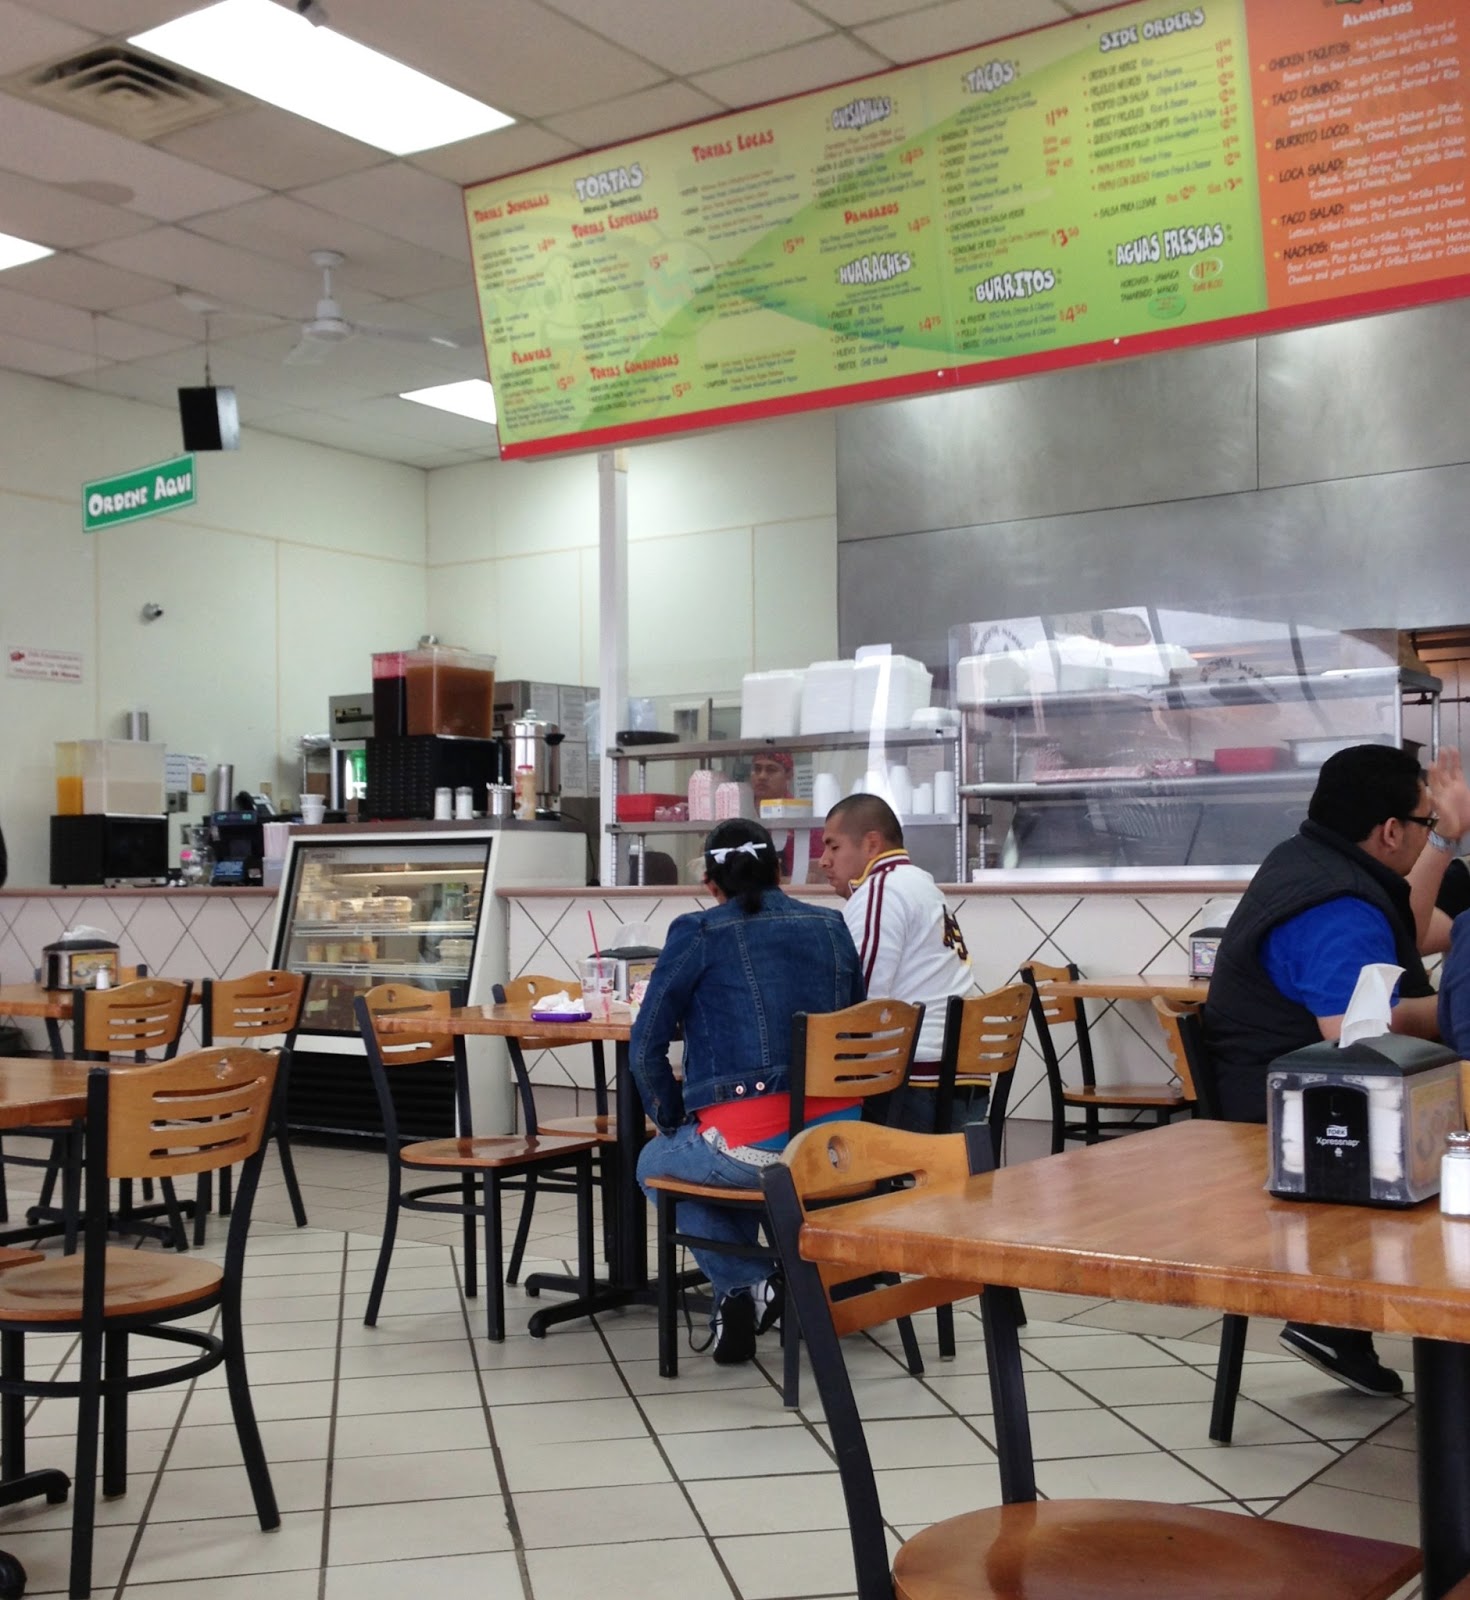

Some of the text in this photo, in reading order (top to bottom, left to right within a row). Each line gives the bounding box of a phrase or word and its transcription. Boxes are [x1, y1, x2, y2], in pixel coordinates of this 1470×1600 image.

[1098, 8, 1205, 53] SIDE ORDERS
[965, 59, 1014, 95] TACOS
[1271, 88, 1298, 106] TACO
[736, 125, 774, 152] LOCAS
[1275, 129, 1318, 150] BURRITO
[1320, 122, 1349, 140] LOCO:
[575, 163, 644, 202] TORTAS
[1278, 166, 1303, 182] LOCA
[1307, 157, 1344, 176] SALAD:
[1280, 210, 1306, 226] TACO
[1309, 202, 1344, 221] SALAD:
[1115, 223, 1225, 267] AGUAS FRESCAS
[1282, 240, 1328, 260] NACHOS:
[838, 251, 912, 286] HUARACHES
[975, 267, 1056, 303] BURRITOS
[87, 473, 192, 517] ORDENE AQUI
[1316, 1137, 1360, 1147] Xpressnap
